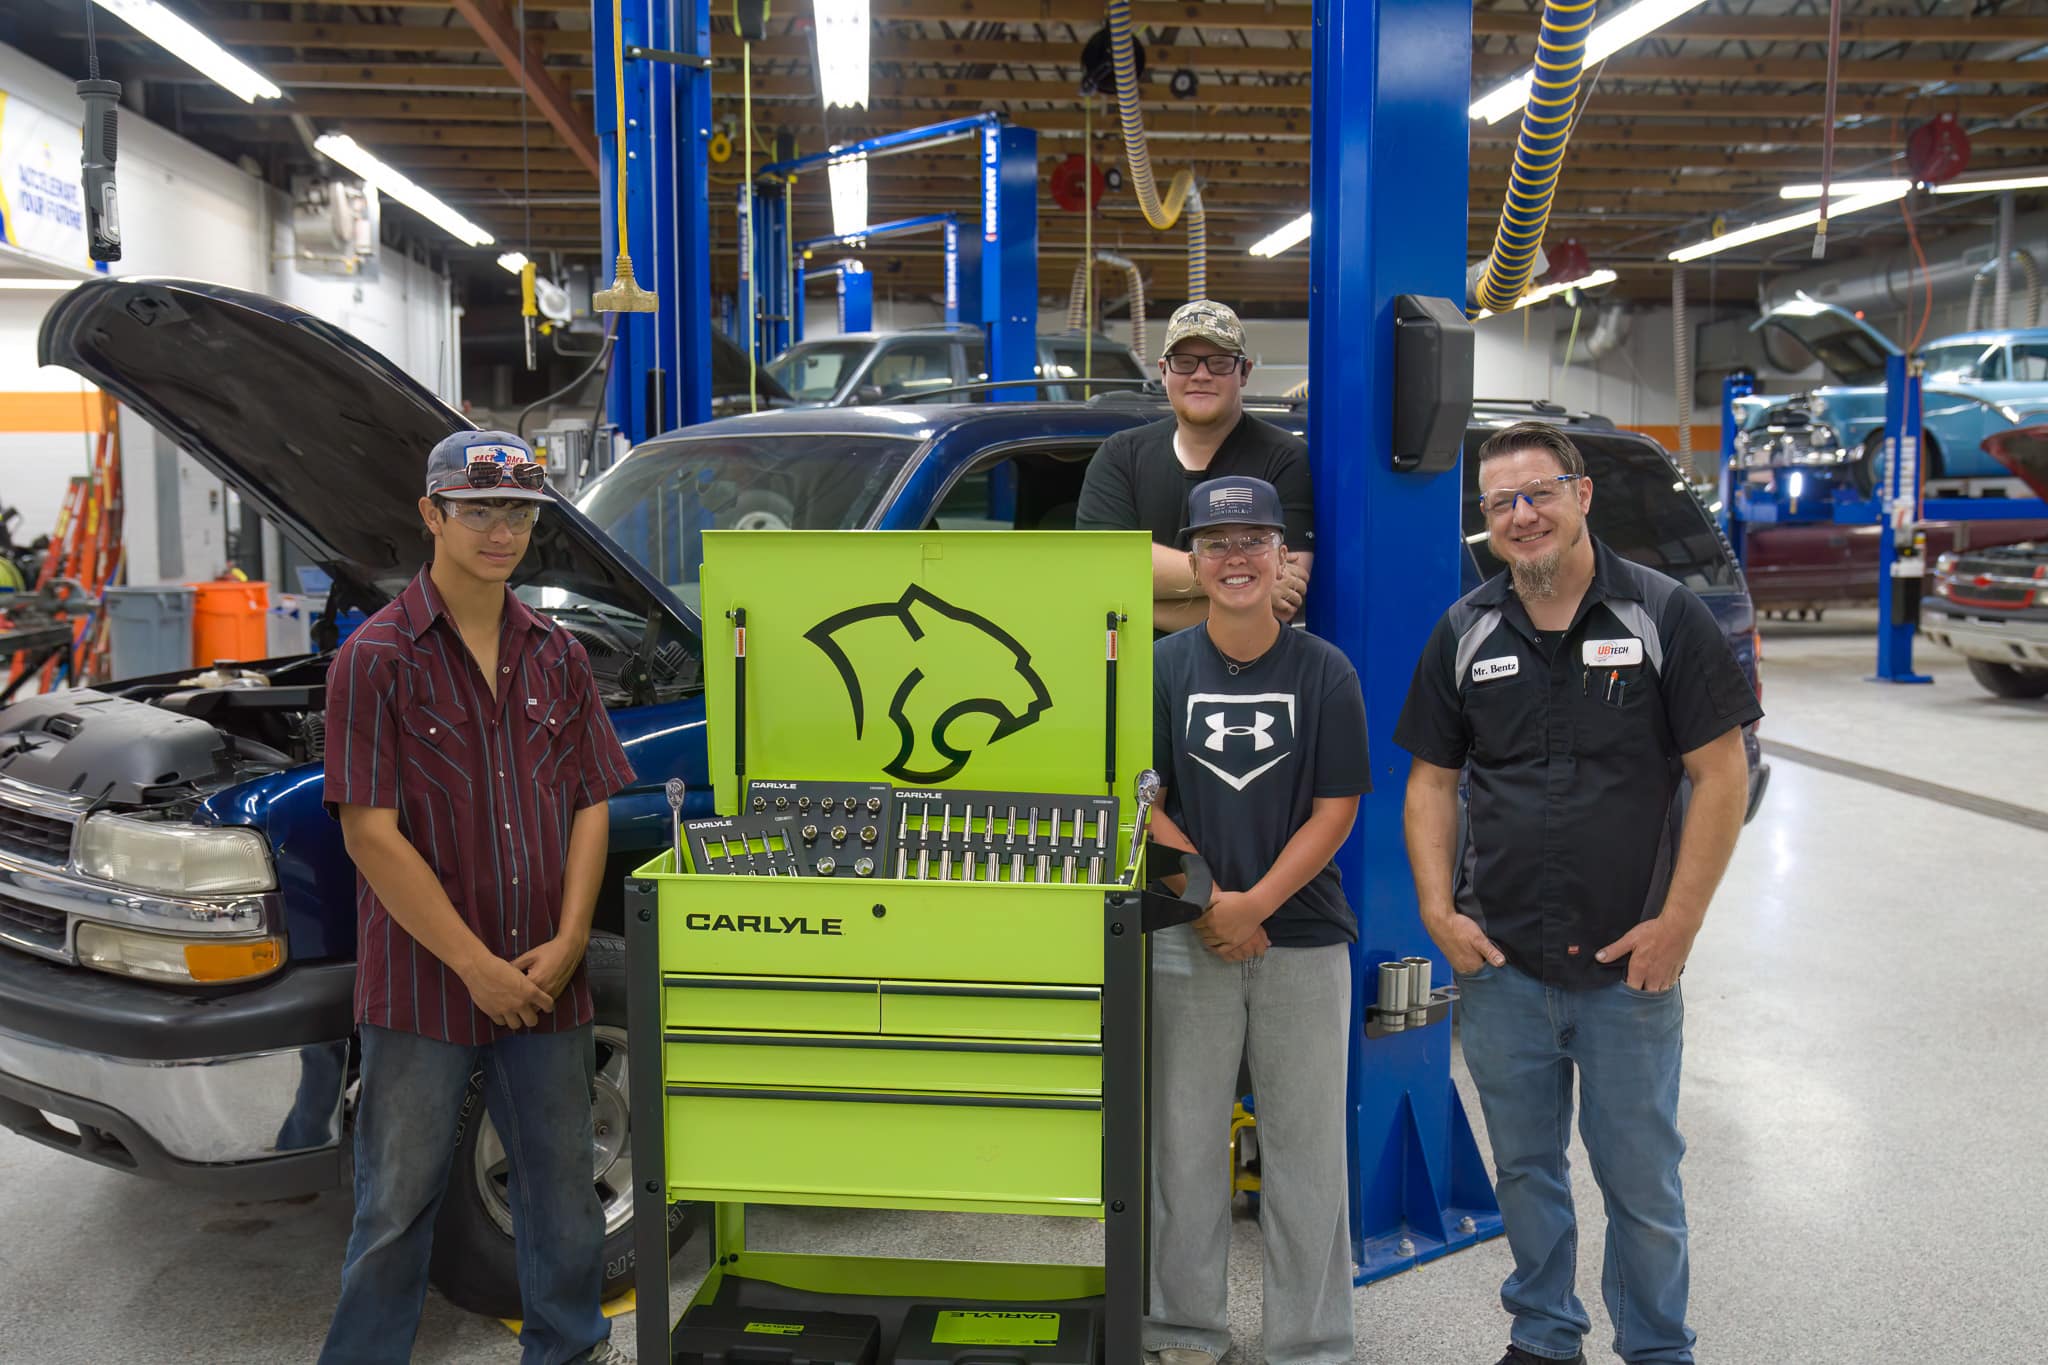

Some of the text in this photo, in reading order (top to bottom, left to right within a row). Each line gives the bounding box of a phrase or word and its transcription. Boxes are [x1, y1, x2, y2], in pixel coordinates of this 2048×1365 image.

[1473, 663, 1517, 677] Mr. Bentz
[751, 782, 797, 790] CARLYLE
[895, 791, 942, 799] CARLYLE
[688, 819, 733, 830] CARLYLE
[686, 913, 844, 936] CARLYLE
[950, 1311, 1057, 1320] CARLYLE
